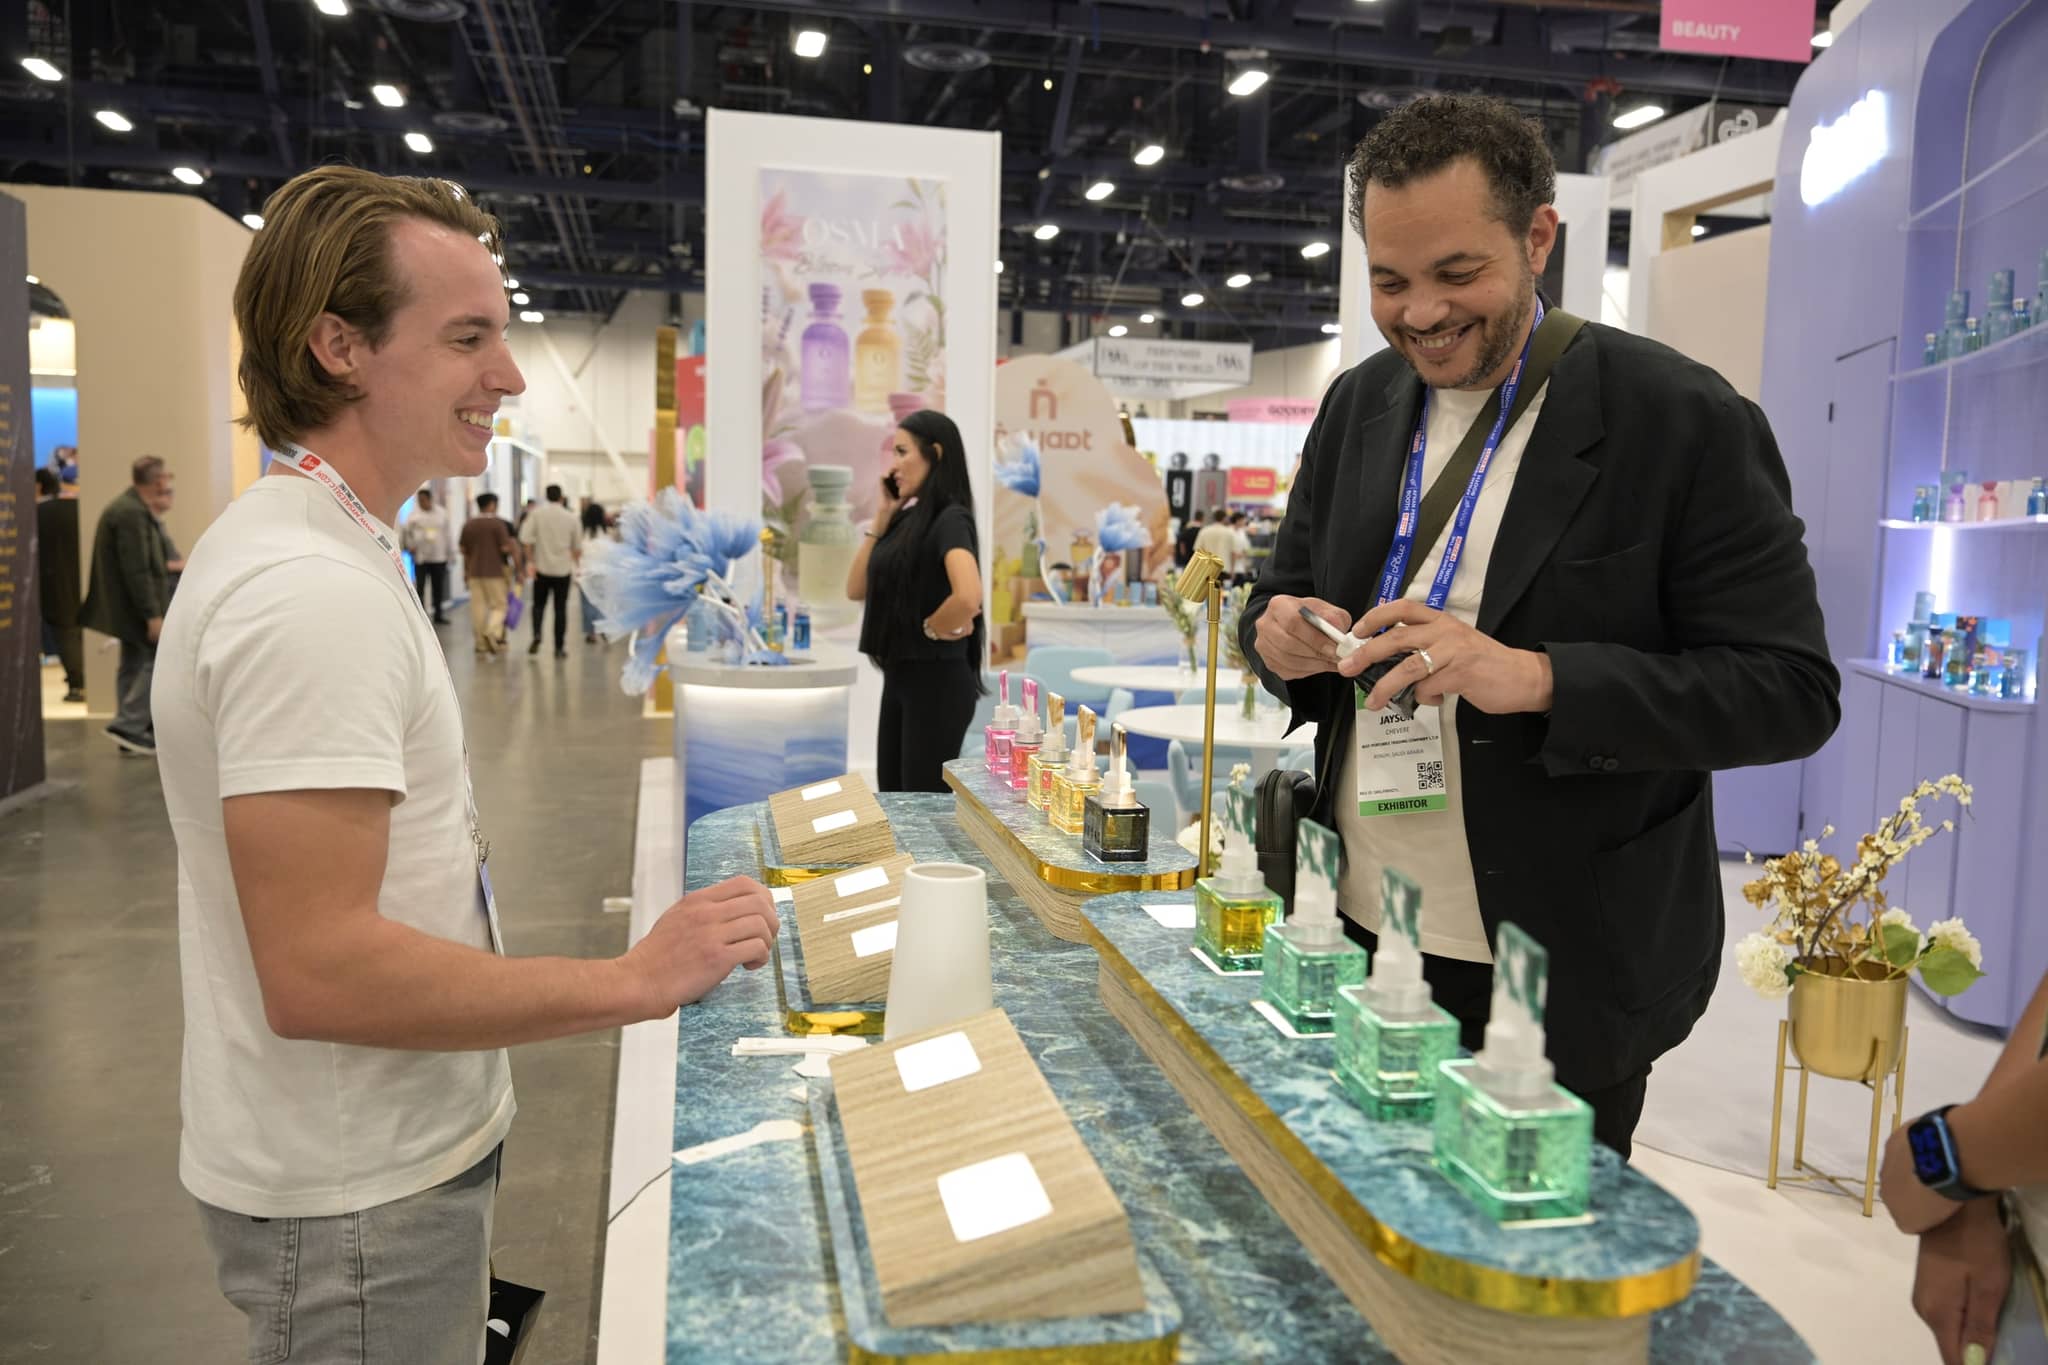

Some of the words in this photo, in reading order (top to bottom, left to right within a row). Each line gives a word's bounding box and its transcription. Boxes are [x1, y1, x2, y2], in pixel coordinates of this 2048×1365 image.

[1672, 20, 1741, 41] BEAUTY
[336, 482, 357, 502] ONLINE
[1403, 488, 1412, 511] BOOTH
[1441, 561, 1454, 585] WORLD
[1380, 573, 1393, 597] BOOTH
[1378, 799, 1428, 812] EXHIBITOR
